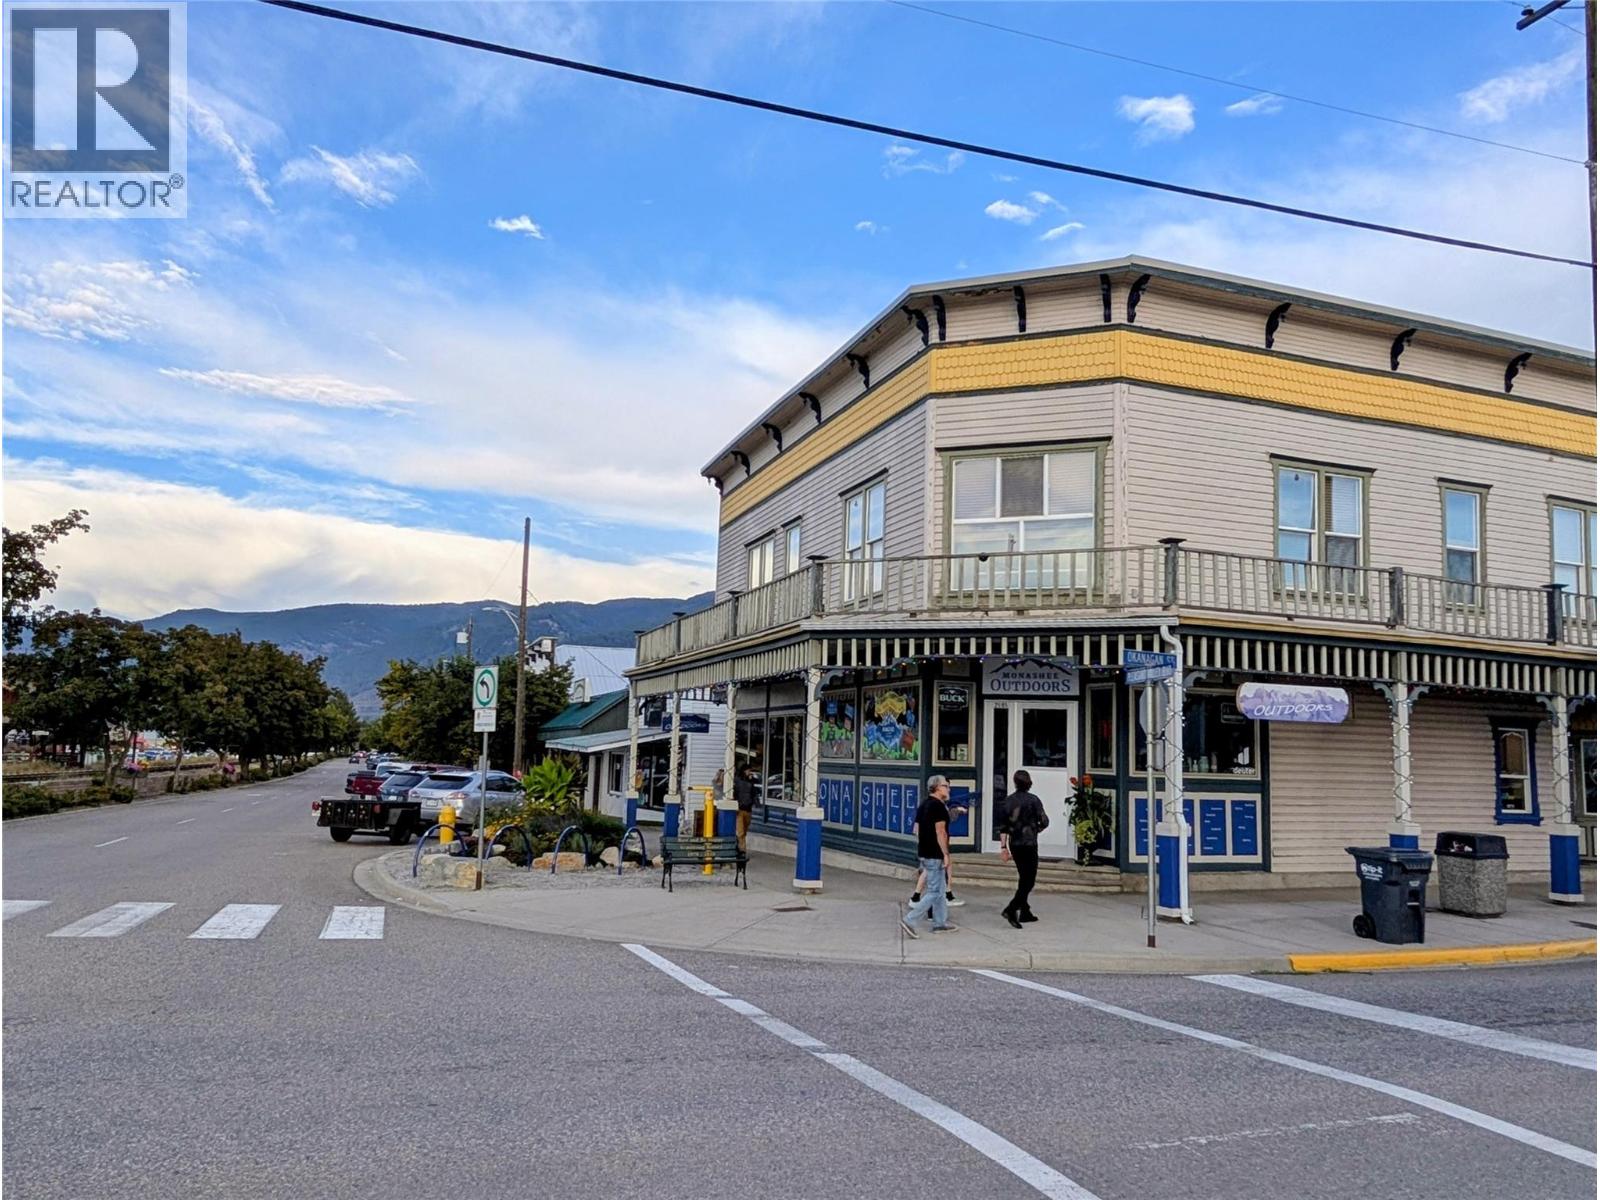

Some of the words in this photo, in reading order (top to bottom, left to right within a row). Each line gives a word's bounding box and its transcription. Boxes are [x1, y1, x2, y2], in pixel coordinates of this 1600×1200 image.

[1127, 651, 1164, 665] OKANAGAN
[1002, 671, 1060, 680] MONASHEE
[990, 678, 1072, 693] OUTDOORS
[939, 694, 965, 703] BUCK
[1253, 703, 1334, 717] OUTDOORS
